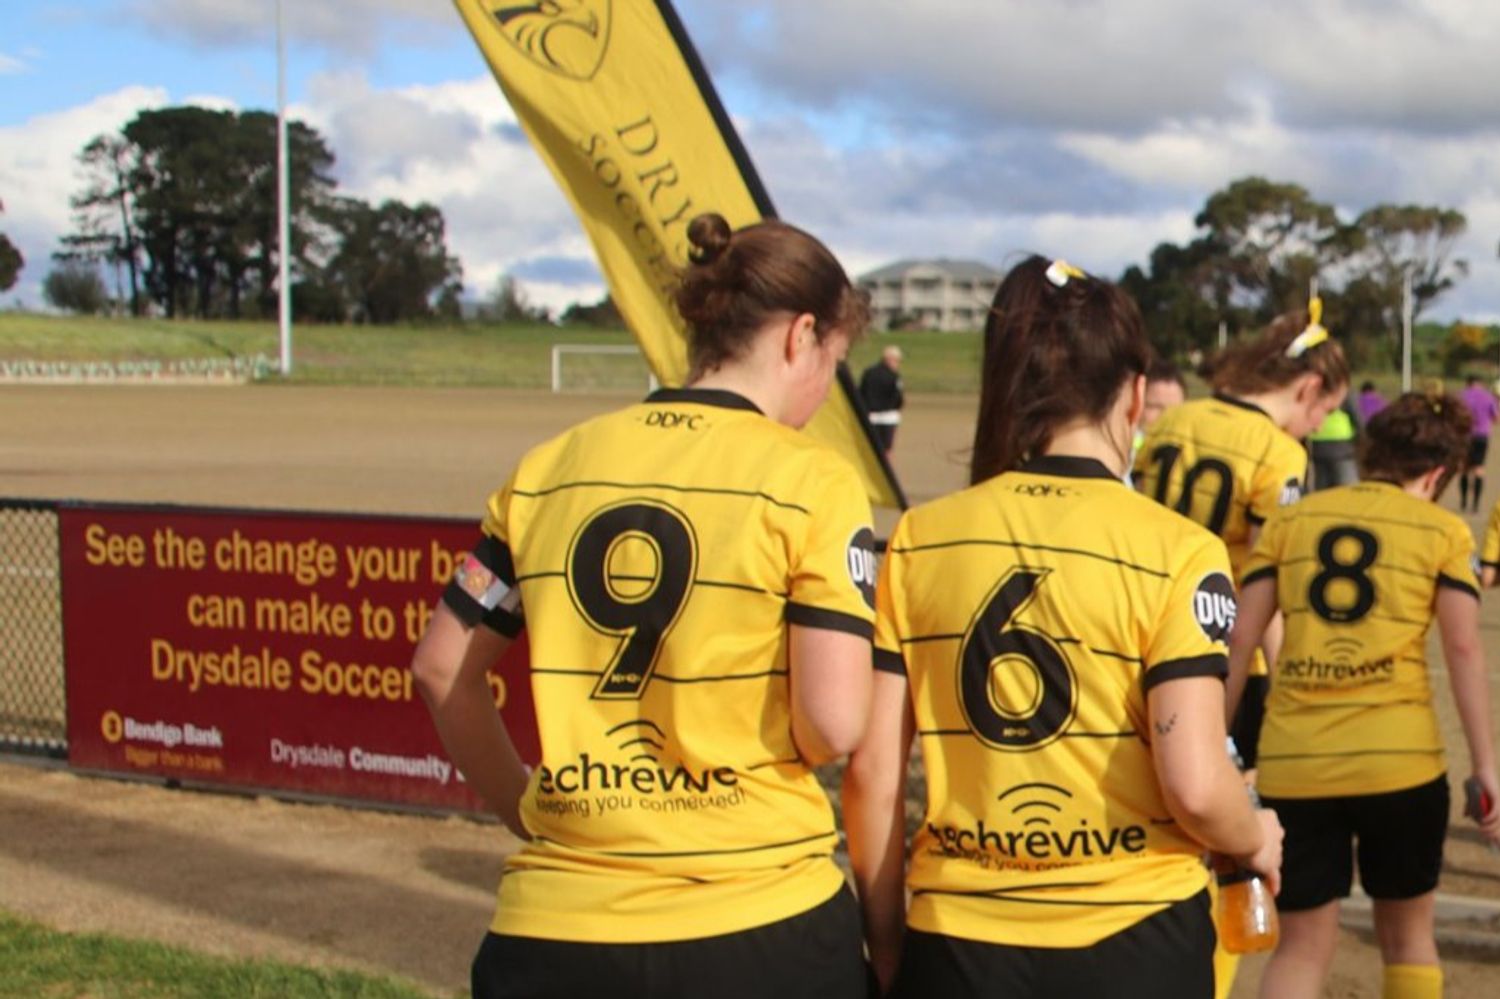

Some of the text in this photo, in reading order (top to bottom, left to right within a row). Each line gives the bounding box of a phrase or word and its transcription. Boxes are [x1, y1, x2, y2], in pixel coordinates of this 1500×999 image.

[616, 115, 692, 250] DRY
[1152, 442, 1233, 536] 10
[86, 523, 145, 566] See
[154, 527, 206, 570] the
[214, 530, 337, 586] change
[346, 543, 422, 589] your
[1308, 523, 1379, 624] 8
[187, 594, 246, 630] can
[255, 593, 353, 638] make
[361, 598, 396, 641] to
[567, 497, 699, 700] 9
[151, 638, 414, 701] Drysdale Soccer
[956, 564, 1079, 753] 6
[124, 716, 223, 749] Bendigo Bank
[269, 738, 346, 769] Drysdale
[350, 746, 451, 785] Community
[595, 793, 633, 817] you
